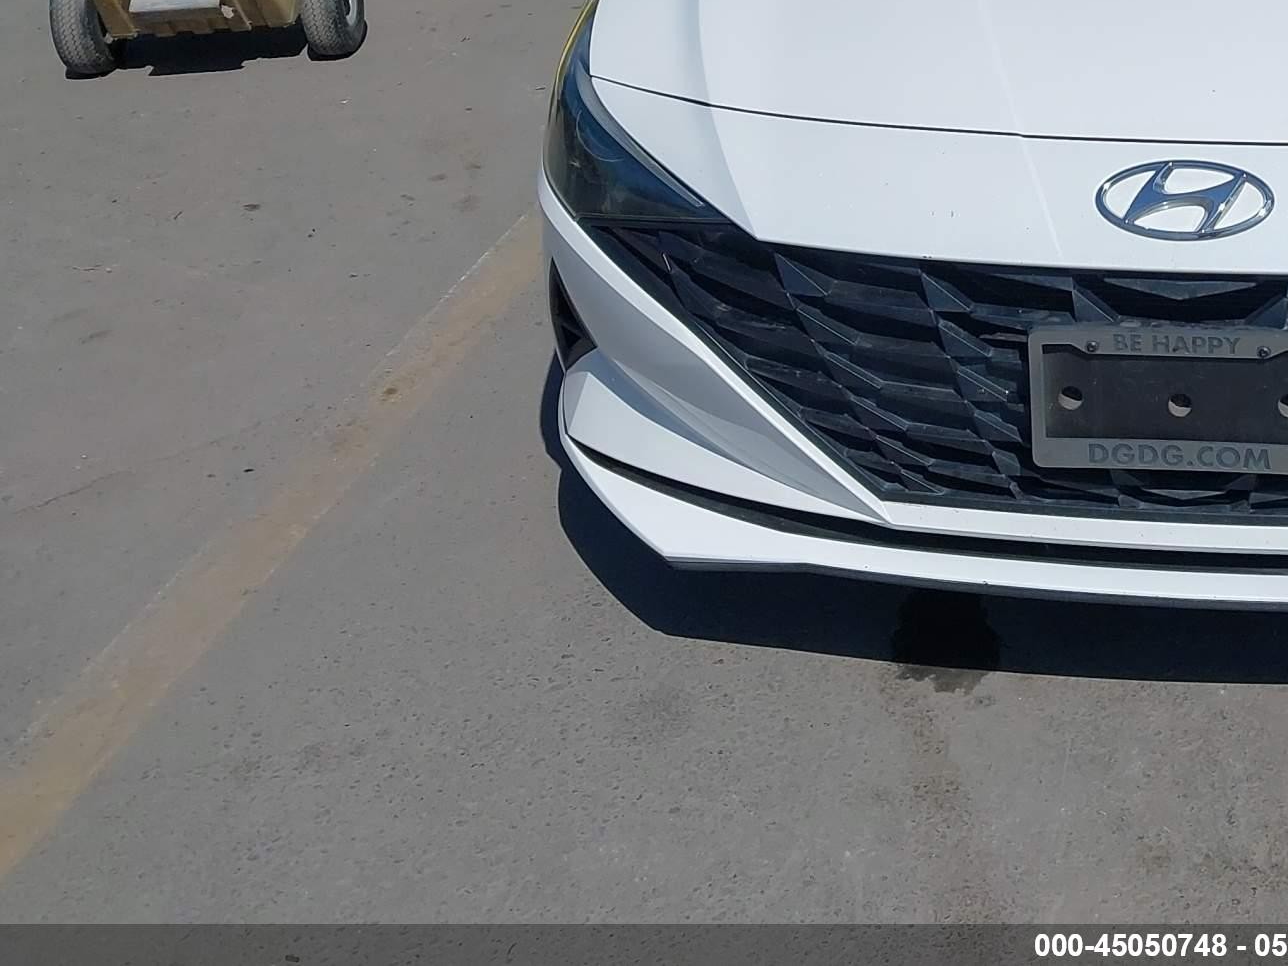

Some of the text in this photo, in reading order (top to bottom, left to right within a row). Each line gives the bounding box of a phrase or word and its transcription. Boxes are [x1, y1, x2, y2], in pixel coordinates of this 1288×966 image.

[1112, 333, 1241, 355] BE HAPPY
[1087, 442, 1272, 471] DGDG.COM
